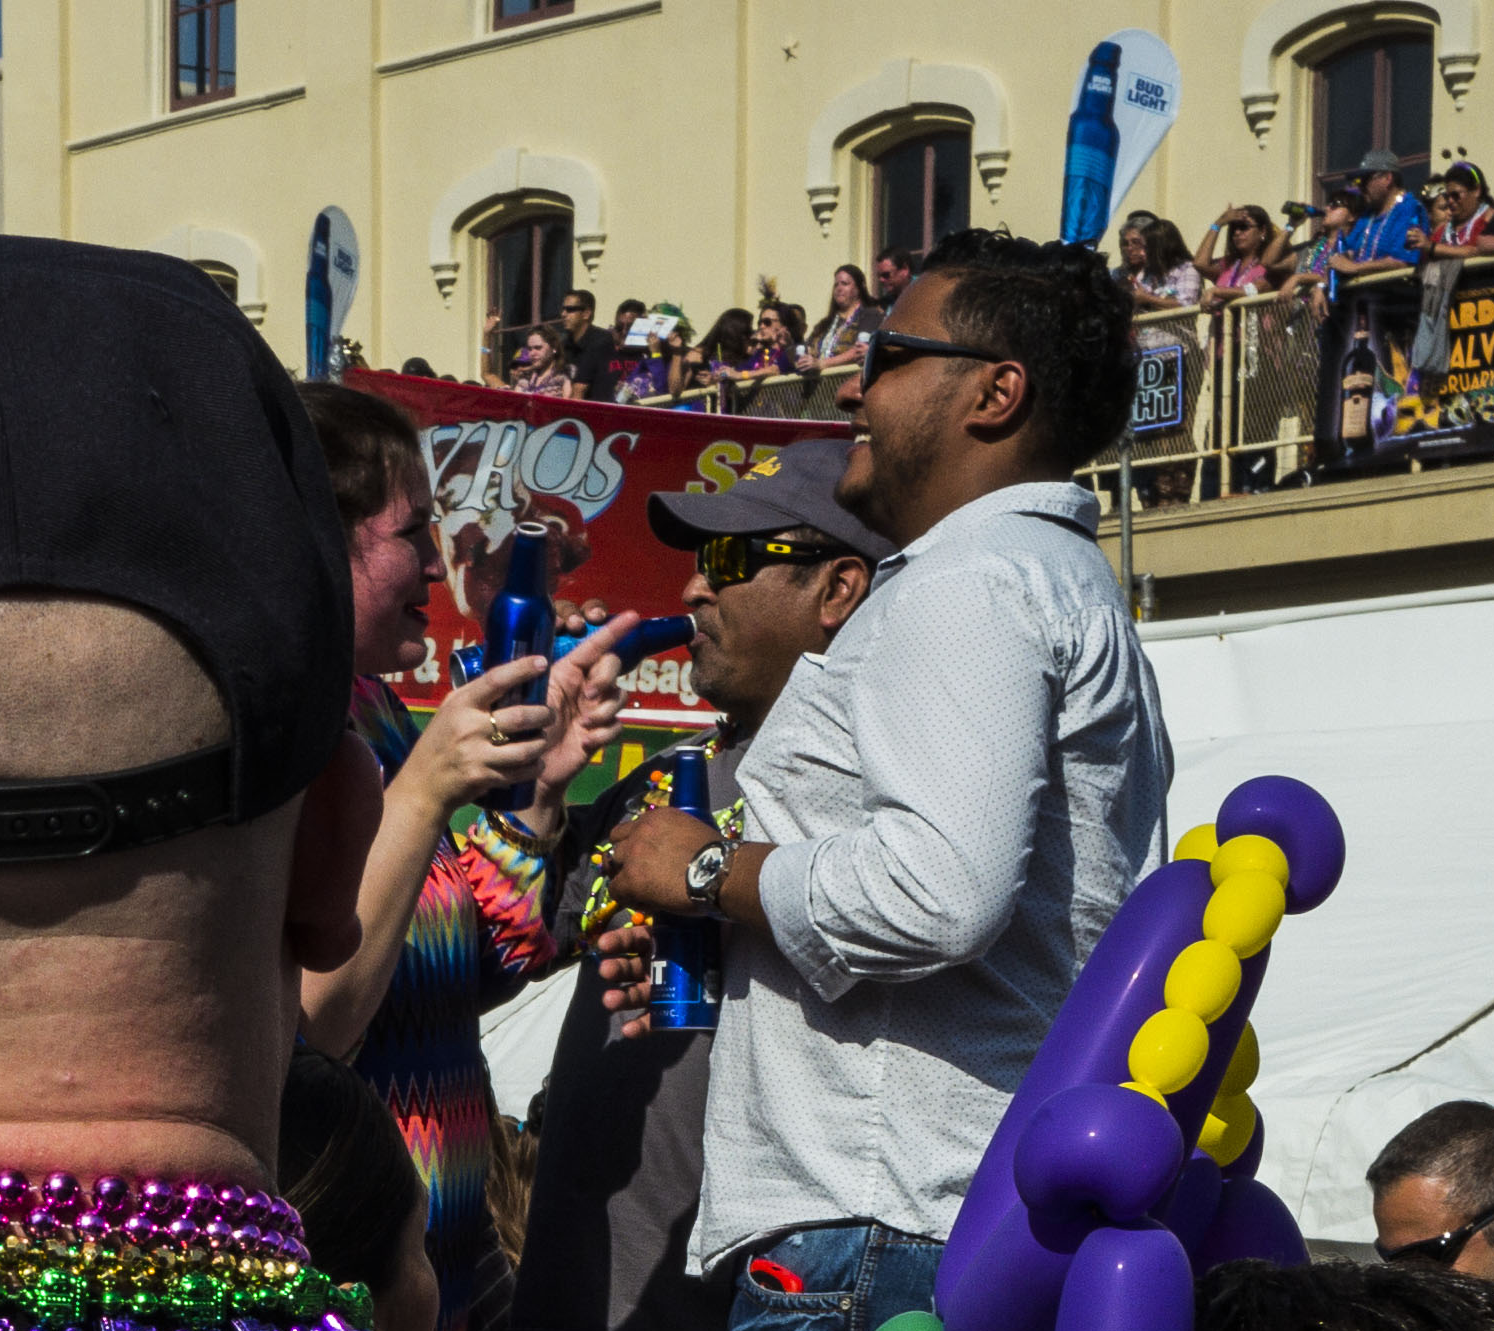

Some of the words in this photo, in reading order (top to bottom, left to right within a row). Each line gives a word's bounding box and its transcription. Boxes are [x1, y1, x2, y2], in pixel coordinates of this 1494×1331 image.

[1127, 89, 1168, 112] LIGHT
[1135, 78, 1164, 98] BUD
[417, 416, 641, 523] YROS
[615, 658, 700, 707] usag
